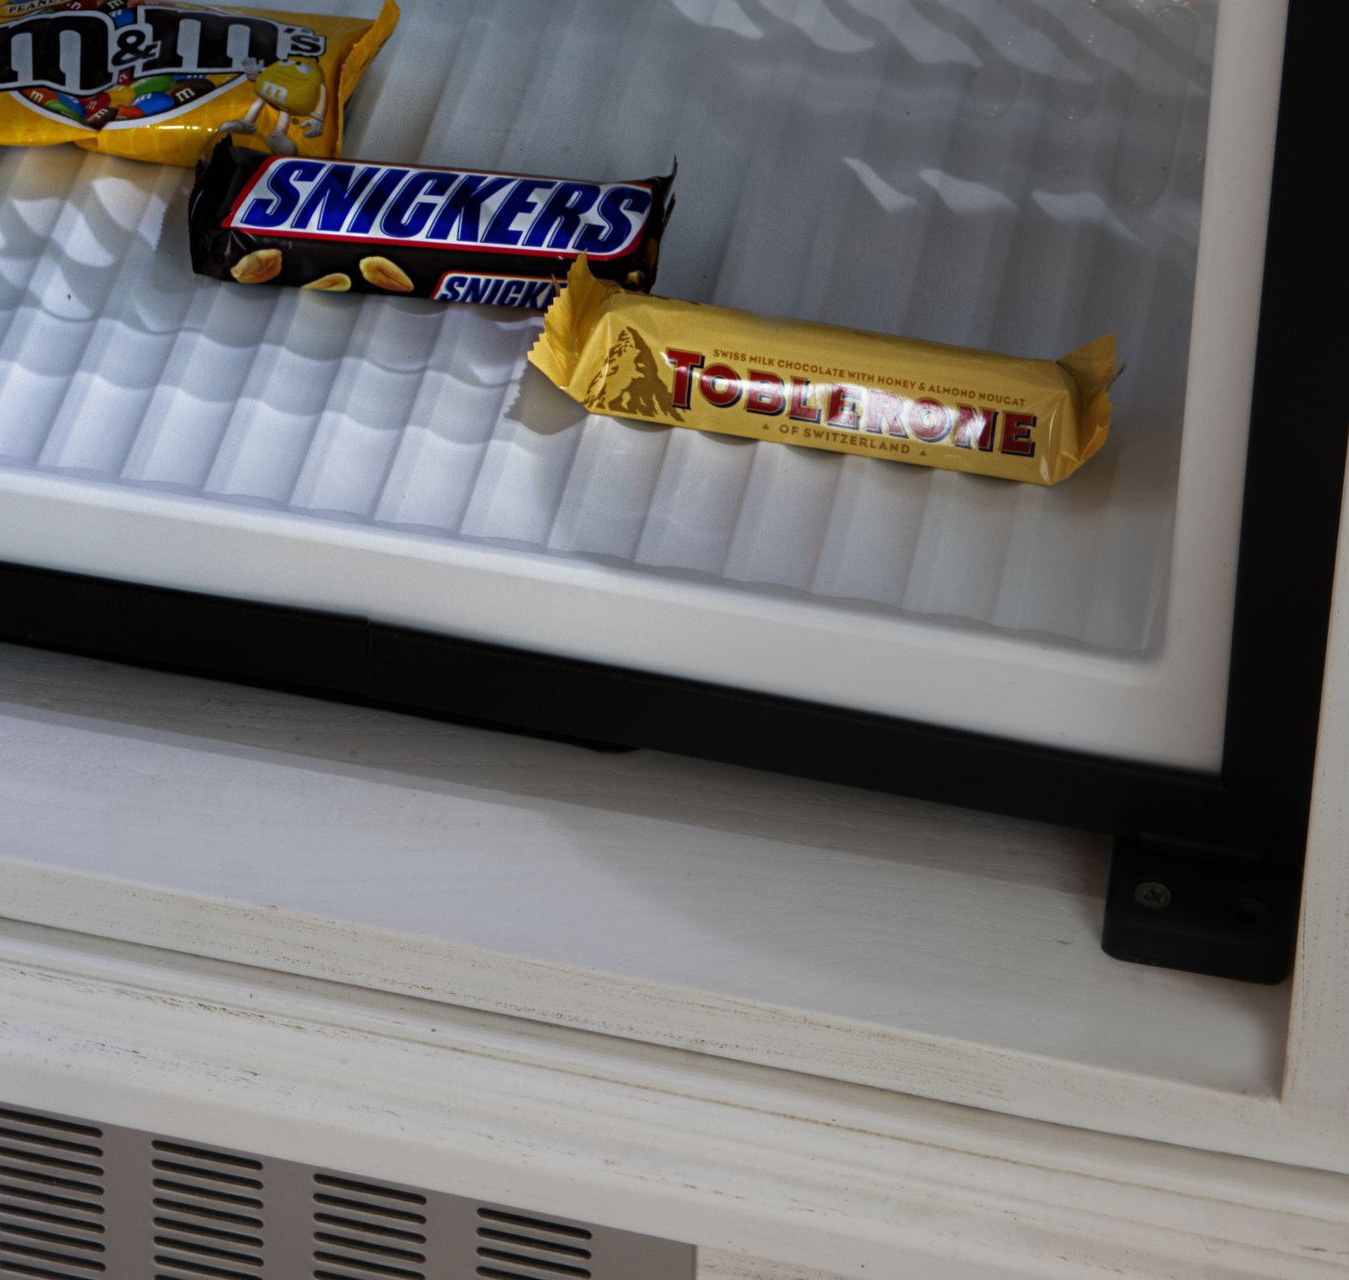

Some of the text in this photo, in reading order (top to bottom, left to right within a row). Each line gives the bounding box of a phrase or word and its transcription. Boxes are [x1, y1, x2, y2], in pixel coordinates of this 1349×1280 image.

[261, 80, 288, 104] m
[240, 159, 651, 255] SNICKERS
[664, 347, 1038, 458] TOBLERONE
[713, 348, 1026, 407] SWISS MILK CHOCOLATE WITH HONEY & ALMOND NOUGAT
[779, 424, 911, 455] OF SWITZERLAND
